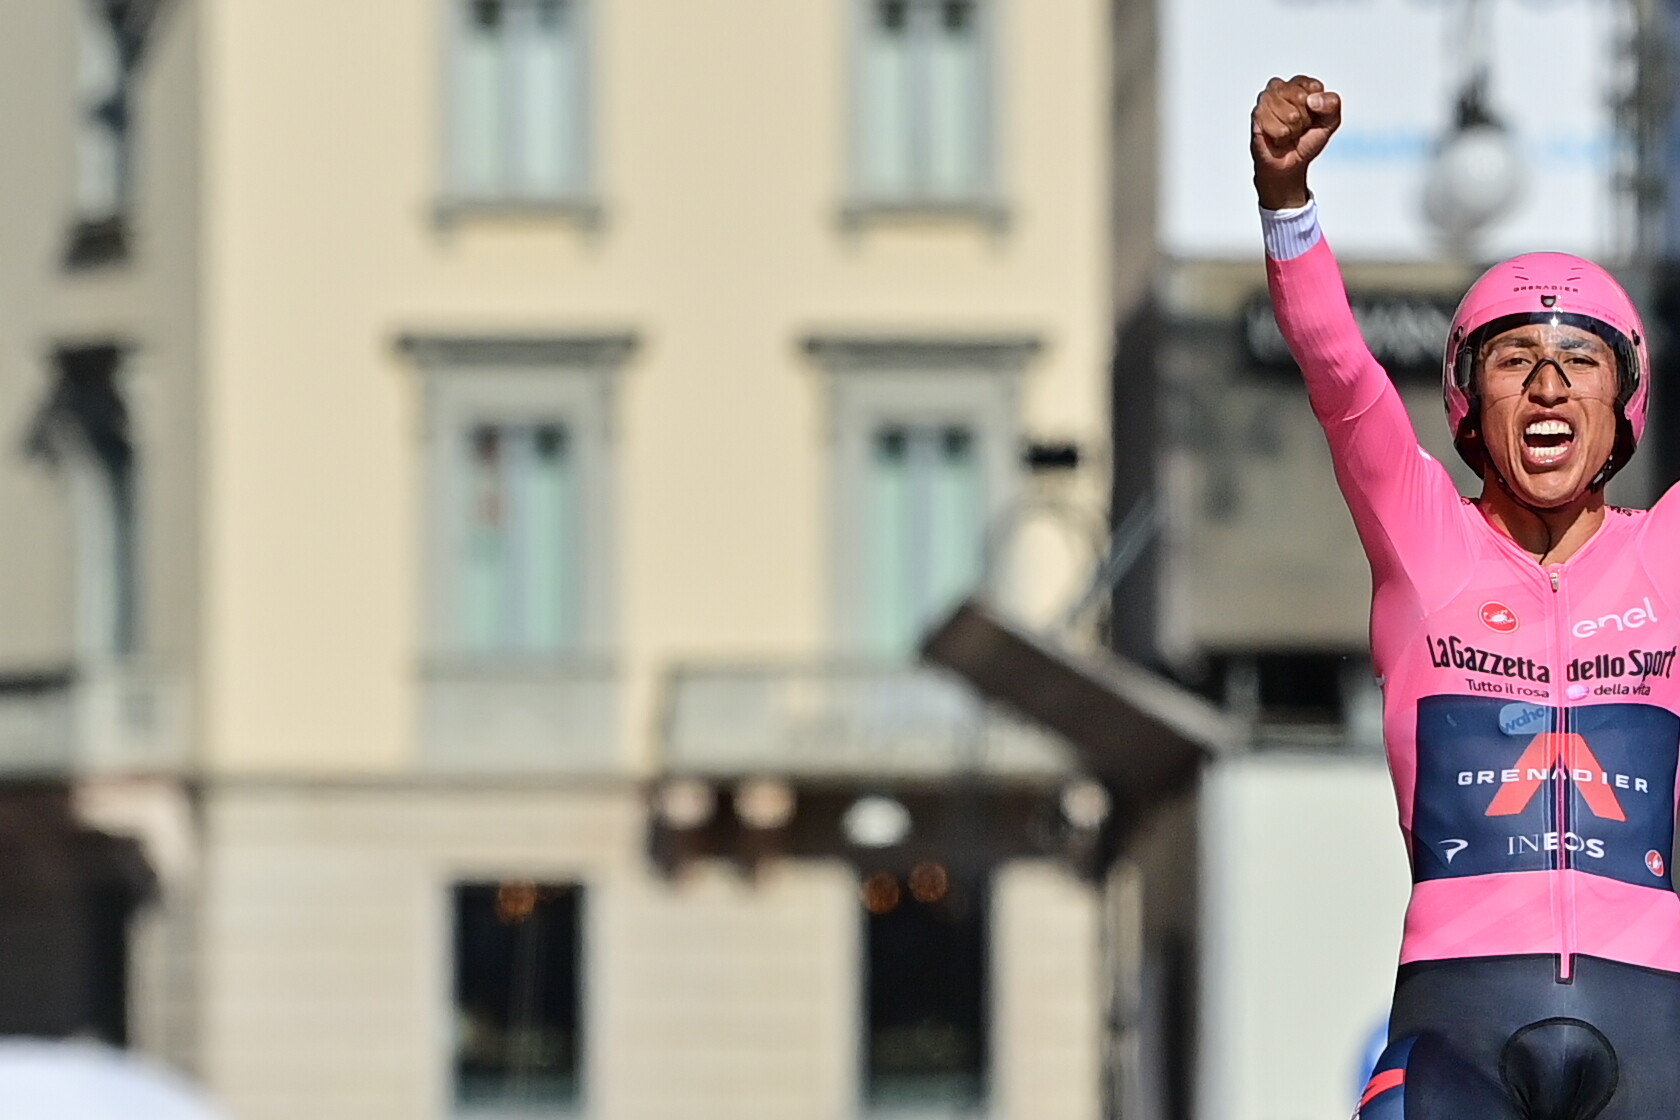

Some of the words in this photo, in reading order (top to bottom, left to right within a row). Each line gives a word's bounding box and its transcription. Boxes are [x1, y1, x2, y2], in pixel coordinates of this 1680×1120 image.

[1572, 596, 1659, 639] enel
[1566, 657, 1626, 683] dello
[1627, 645, 1678, 683] Sport
[1465, 677, 1503, 694] Tutto
[1505, 682, 1514, 695] il
[1516, 686, 1550, 699] rosa
[1593, 683, 1630, 696] della
[1632, 684, 1652, 697] vita
[1457, 768, 1649, 794] GRENADIER
[1506, 831, 1606, 859] INEOS
